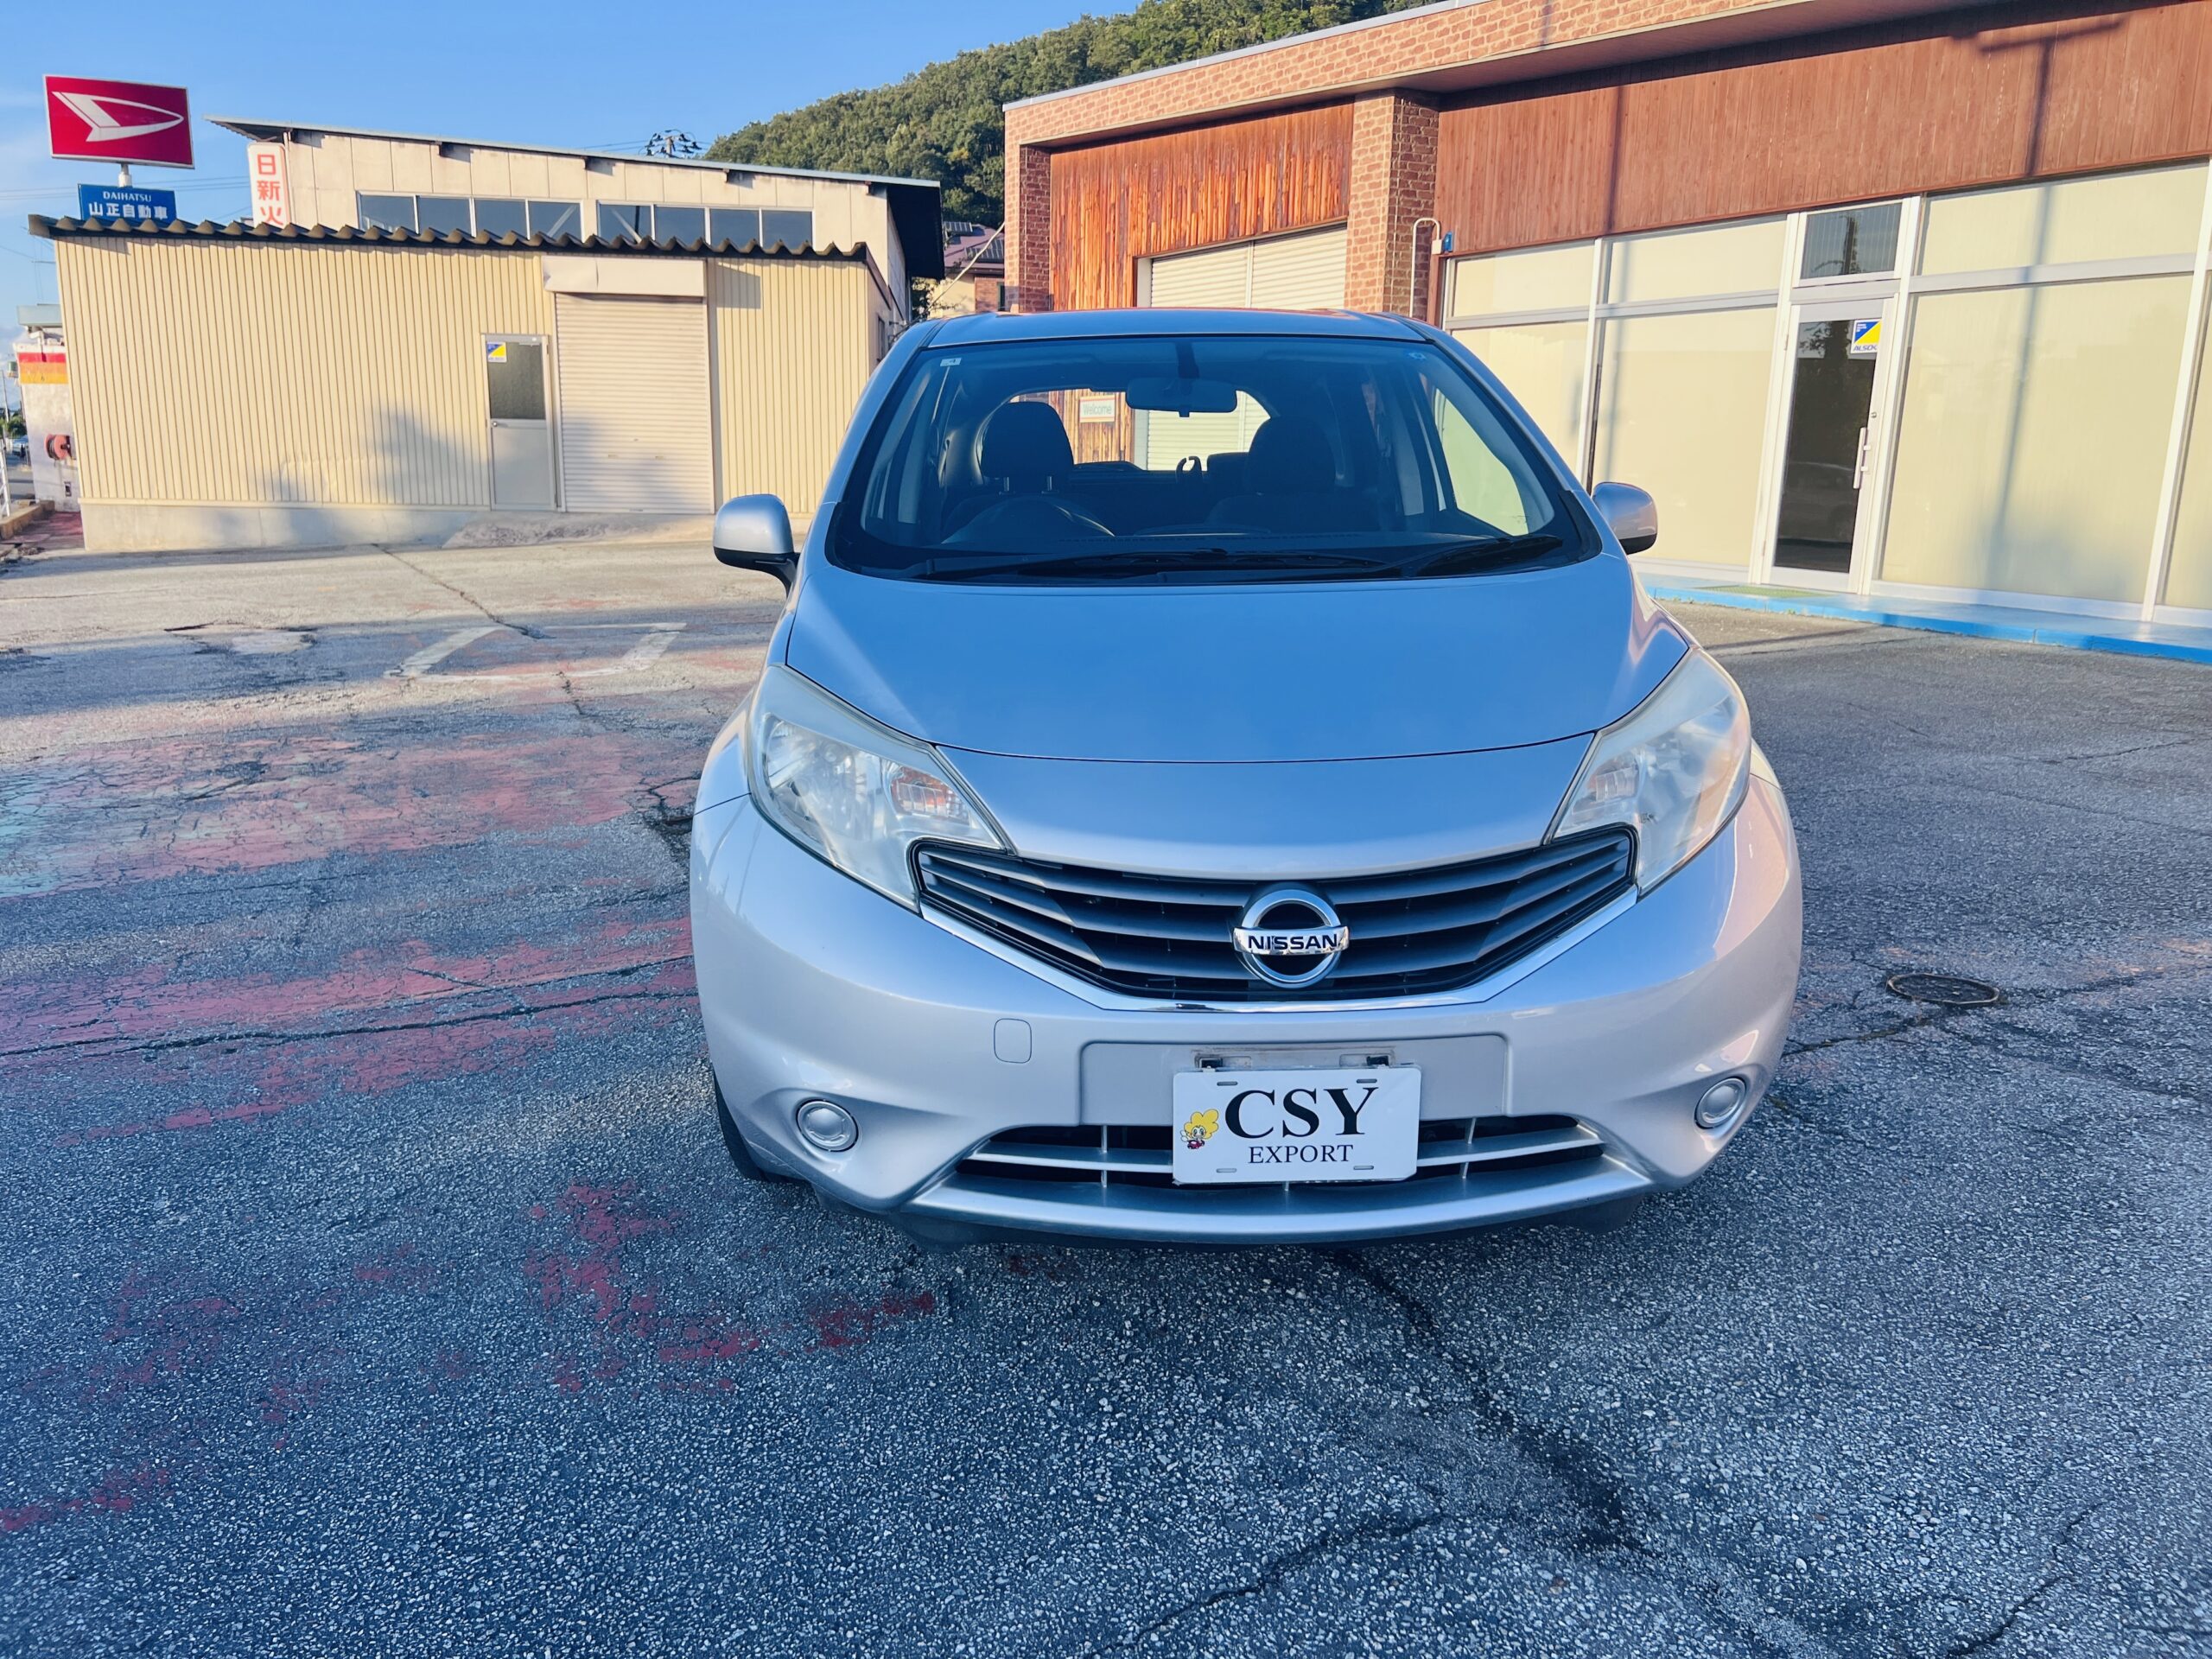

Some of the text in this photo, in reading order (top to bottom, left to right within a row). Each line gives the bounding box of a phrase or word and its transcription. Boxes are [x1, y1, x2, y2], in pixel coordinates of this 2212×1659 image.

[103, 191, 152, 202] DAIHATSU
[257, 154, 284, 225] 日新火
[88, 201, 168, 219] 山正自動車
[1248, 933, 1338, 950] NISSAN
[1224, 1086, 1379, 1139] CSY
[1248, 1144, 1354, 1164] EXPORT
